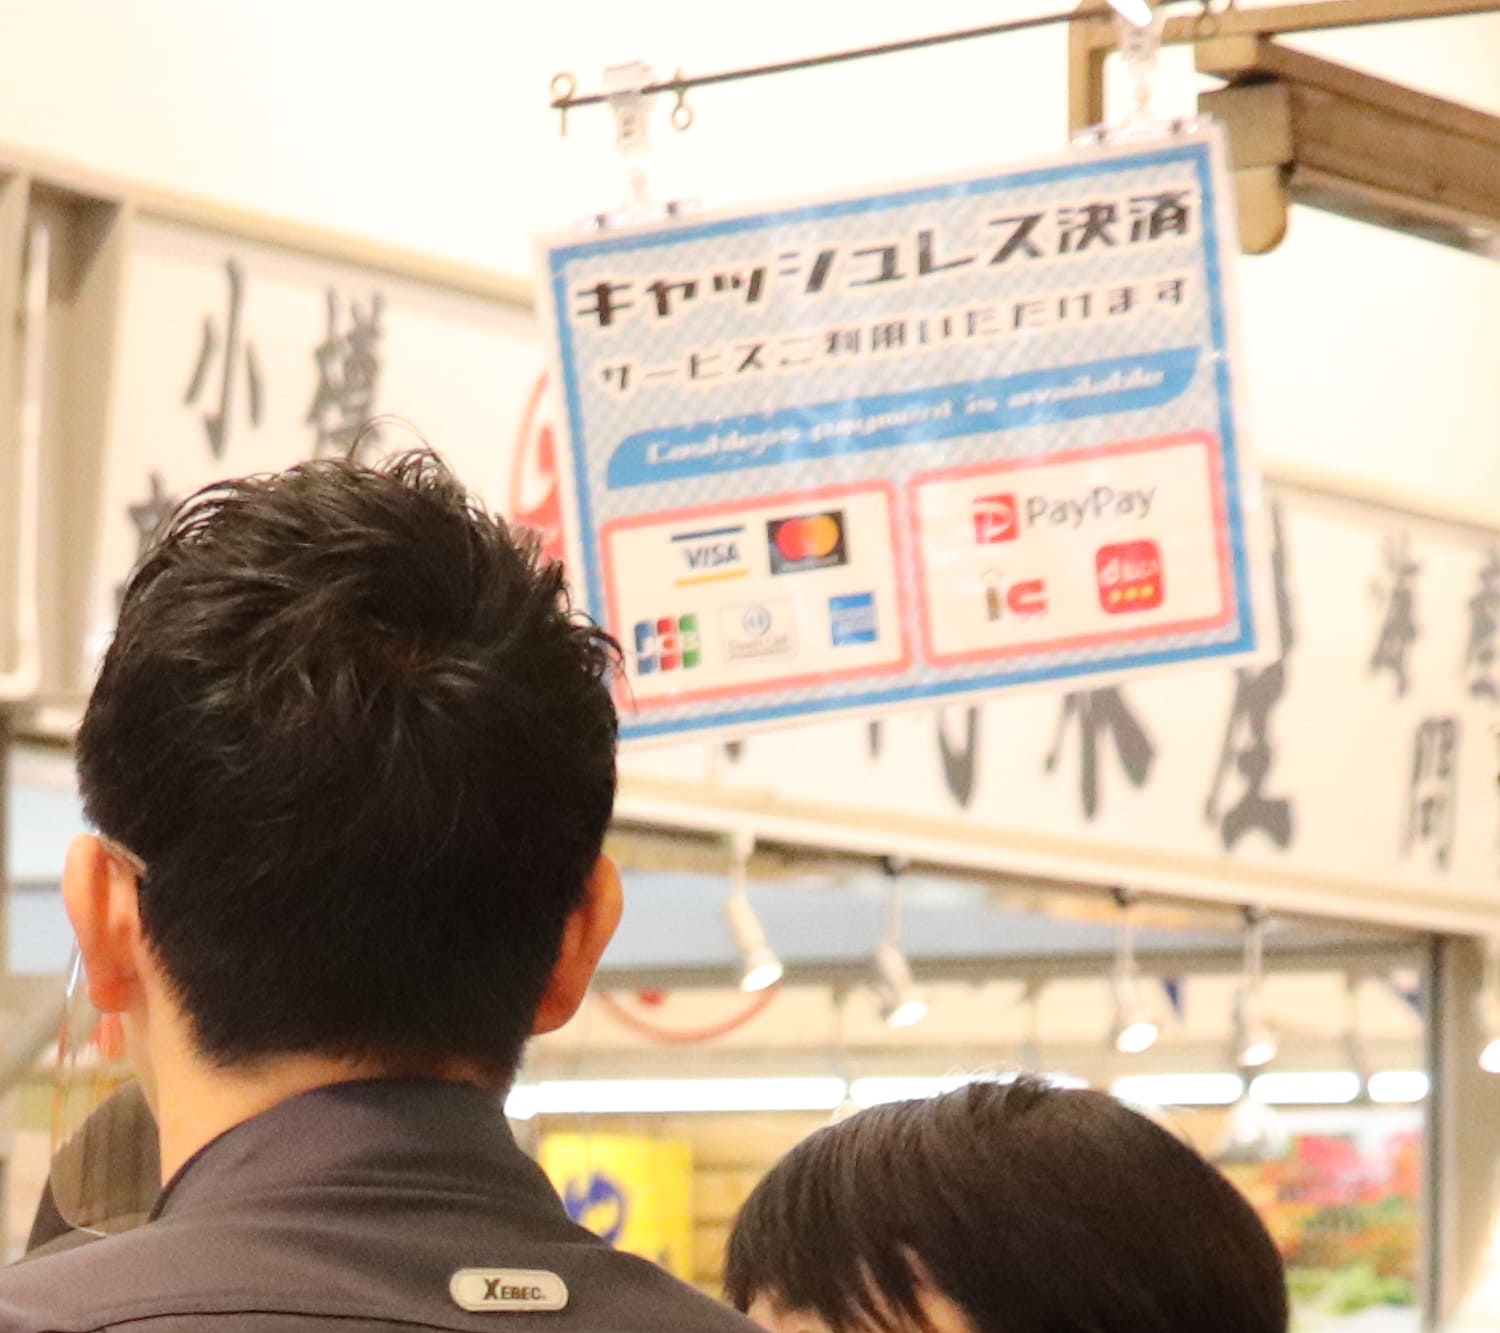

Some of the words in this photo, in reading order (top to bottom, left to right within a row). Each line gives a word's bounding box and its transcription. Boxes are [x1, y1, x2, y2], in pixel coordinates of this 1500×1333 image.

[574, 188, 1198, 328] キャッシュレス決済
[599, 276, 1192, 394] サービスご利用いただけます
[1025, 482, 1160, 529] PayPay
[683, 544, 742, 571] VISA
[481, 1277, 544, 1301] XEBEC
